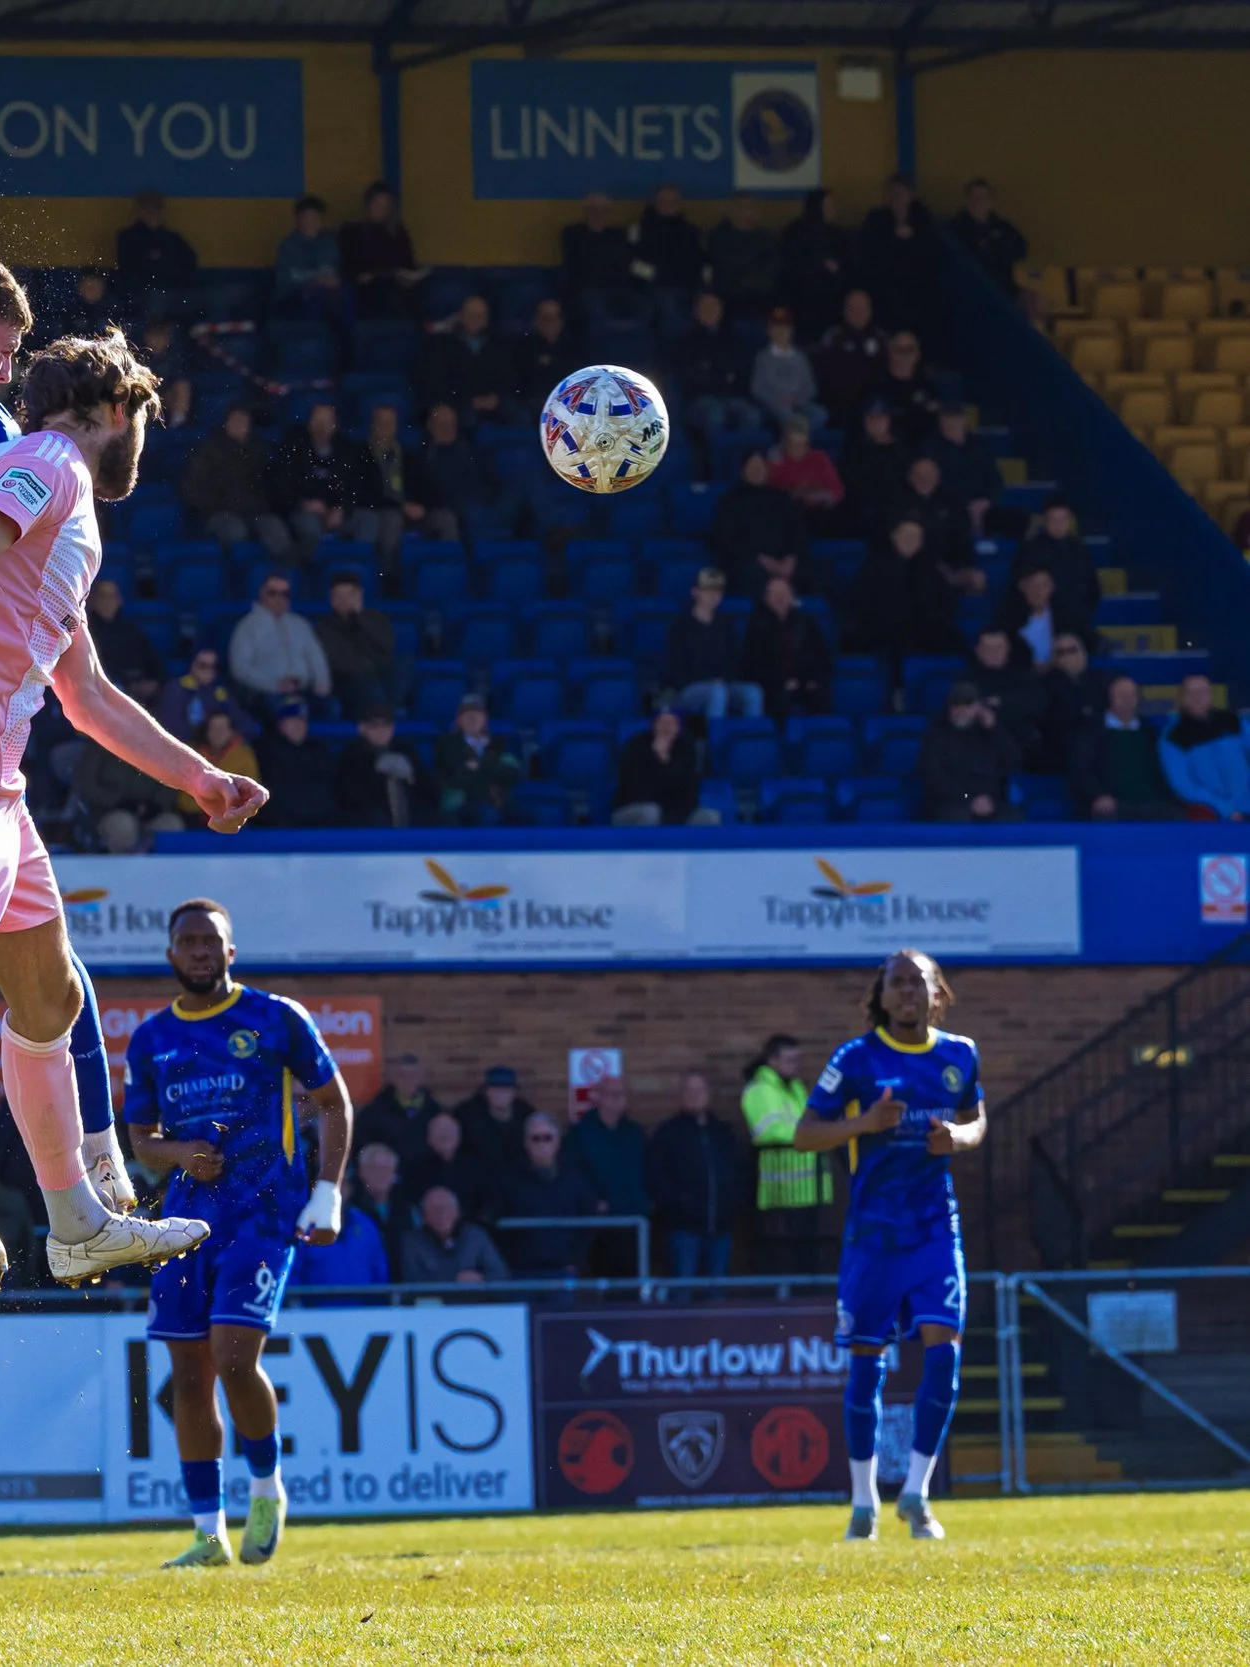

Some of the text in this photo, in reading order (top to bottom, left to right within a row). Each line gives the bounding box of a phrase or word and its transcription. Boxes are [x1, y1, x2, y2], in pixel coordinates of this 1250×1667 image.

[120, 101, 257, 160] YOU
[490, 104, 723, 161] LINNETS
[368, 900, 614, 937] Tapping House
[762, 895, 992, 930] Tapping House
[254, 1266, 275, 1304] 9
[617, 1338, 785, 1378] Thurlow
[342, 1467, 378, 1501] to
[387, 1464, 508, 1500] deliver
